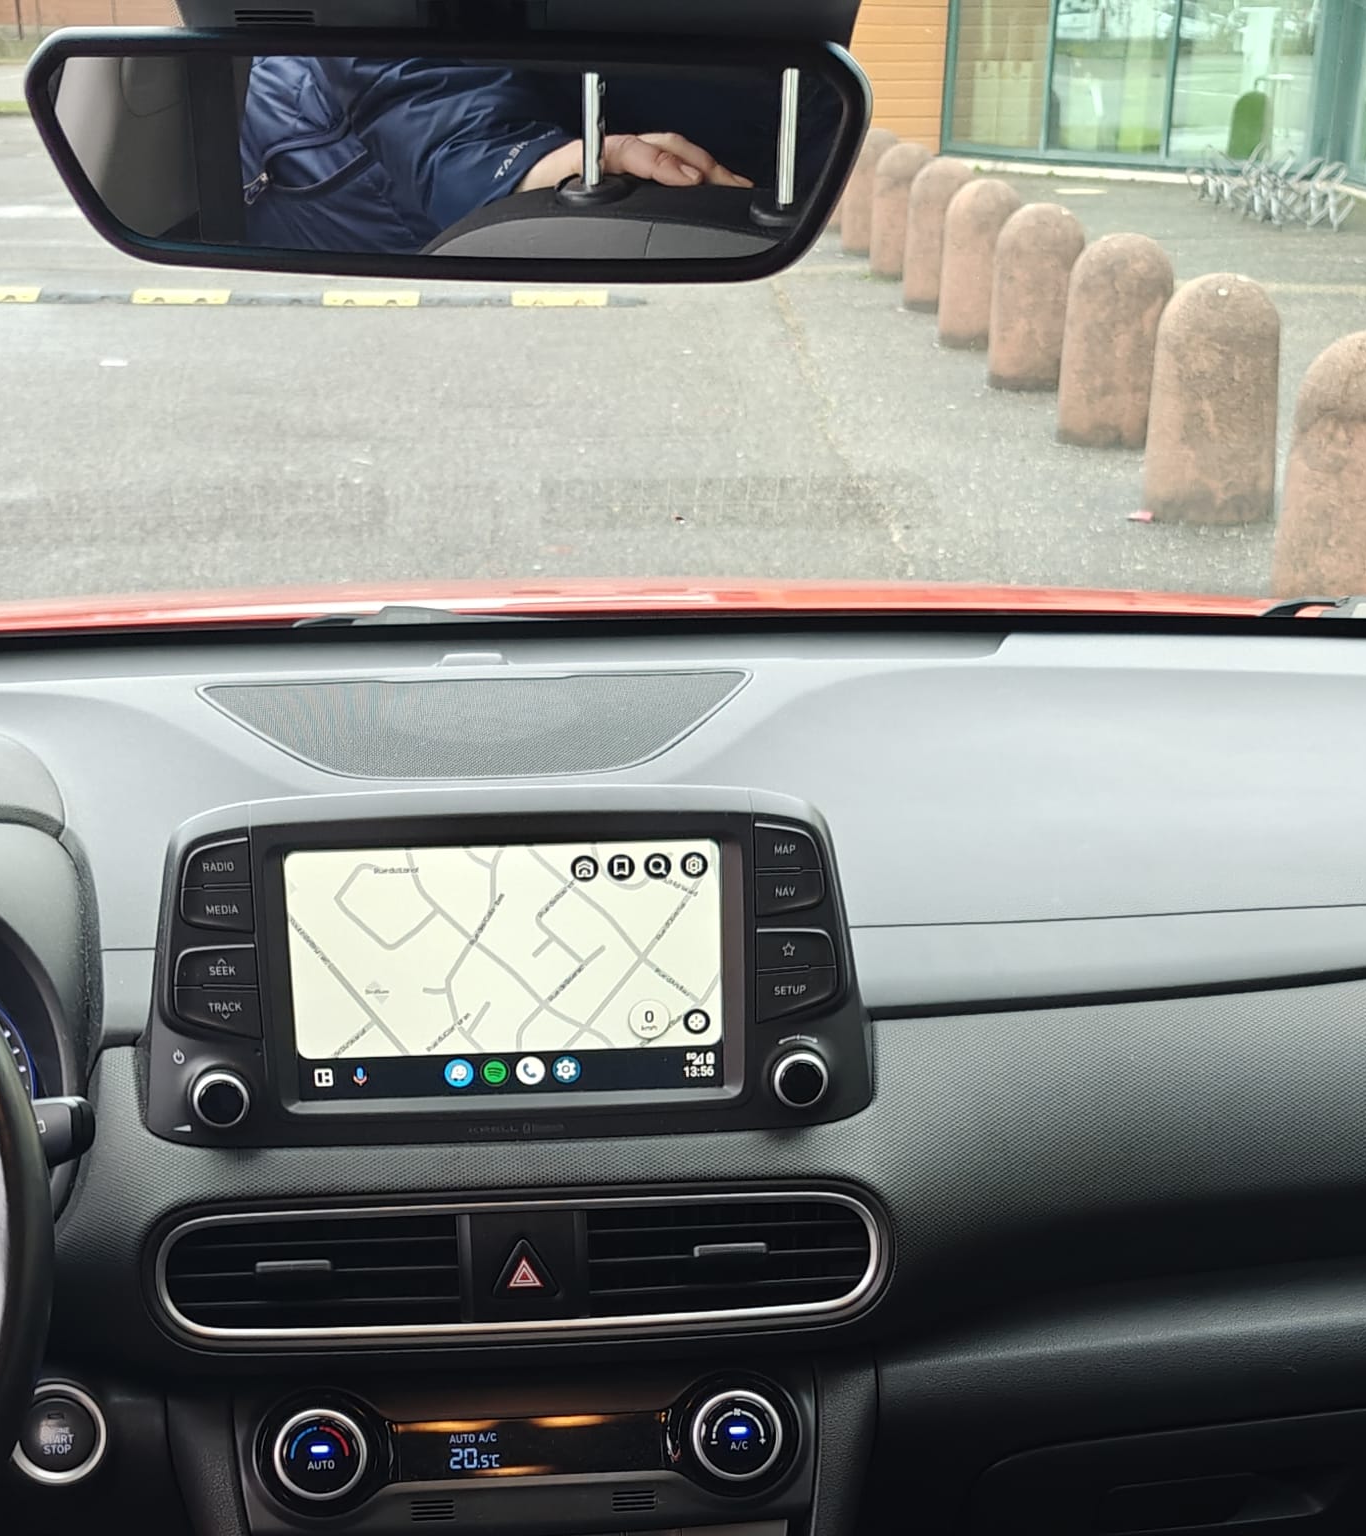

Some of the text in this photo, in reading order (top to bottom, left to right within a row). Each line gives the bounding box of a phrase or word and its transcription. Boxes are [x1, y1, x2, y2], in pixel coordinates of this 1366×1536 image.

[774, 844, 796, 855] MAP
[202, 861, 235, 873] RADIO
[775, 886, 796, 897] NAV
[205, 904, 240, 916] MEDIA
[208, 966, 237, 976] SEEK
[774, 984, 807, 995] SETUP
[208, 1002, 243, 1013] TRACK
[644, 1010, 655, 1024] 0
[449, 1432, 498, 1445] AUTO A/C
[43, 1444, 72, 1455] STOP
[730, 1440, 749, 1450] A/C
[306, 1460, 336, 1472] AUTO
